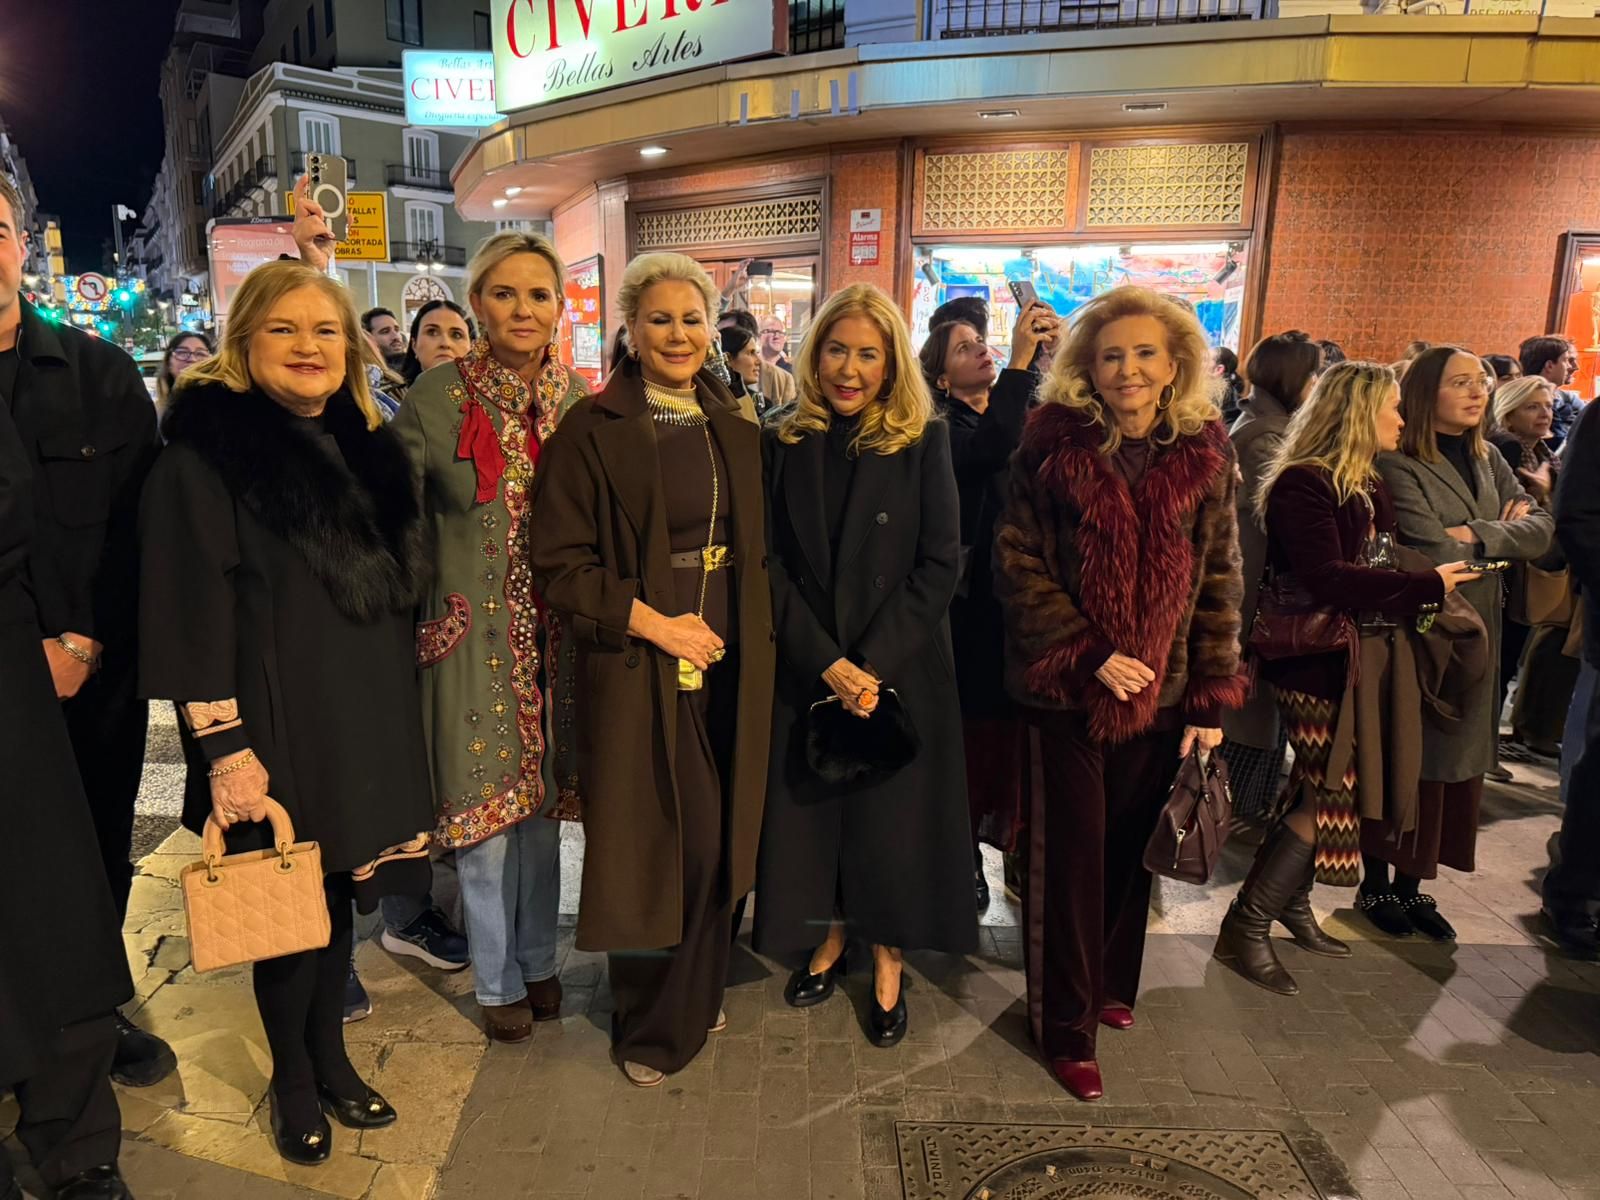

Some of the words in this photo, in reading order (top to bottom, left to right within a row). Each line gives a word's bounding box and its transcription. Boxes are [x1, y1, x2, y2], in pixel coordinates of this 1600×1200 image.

[506, 0, 728, 58] CIVE
[543, 51, 613, 92] Bellas
[632, 30, 703, 71] Artes
[347, 207, 377, 215] TALLAT
[344, 238, 383, 246] CORTADA
[334, 247, 362, 255] OBRAS
